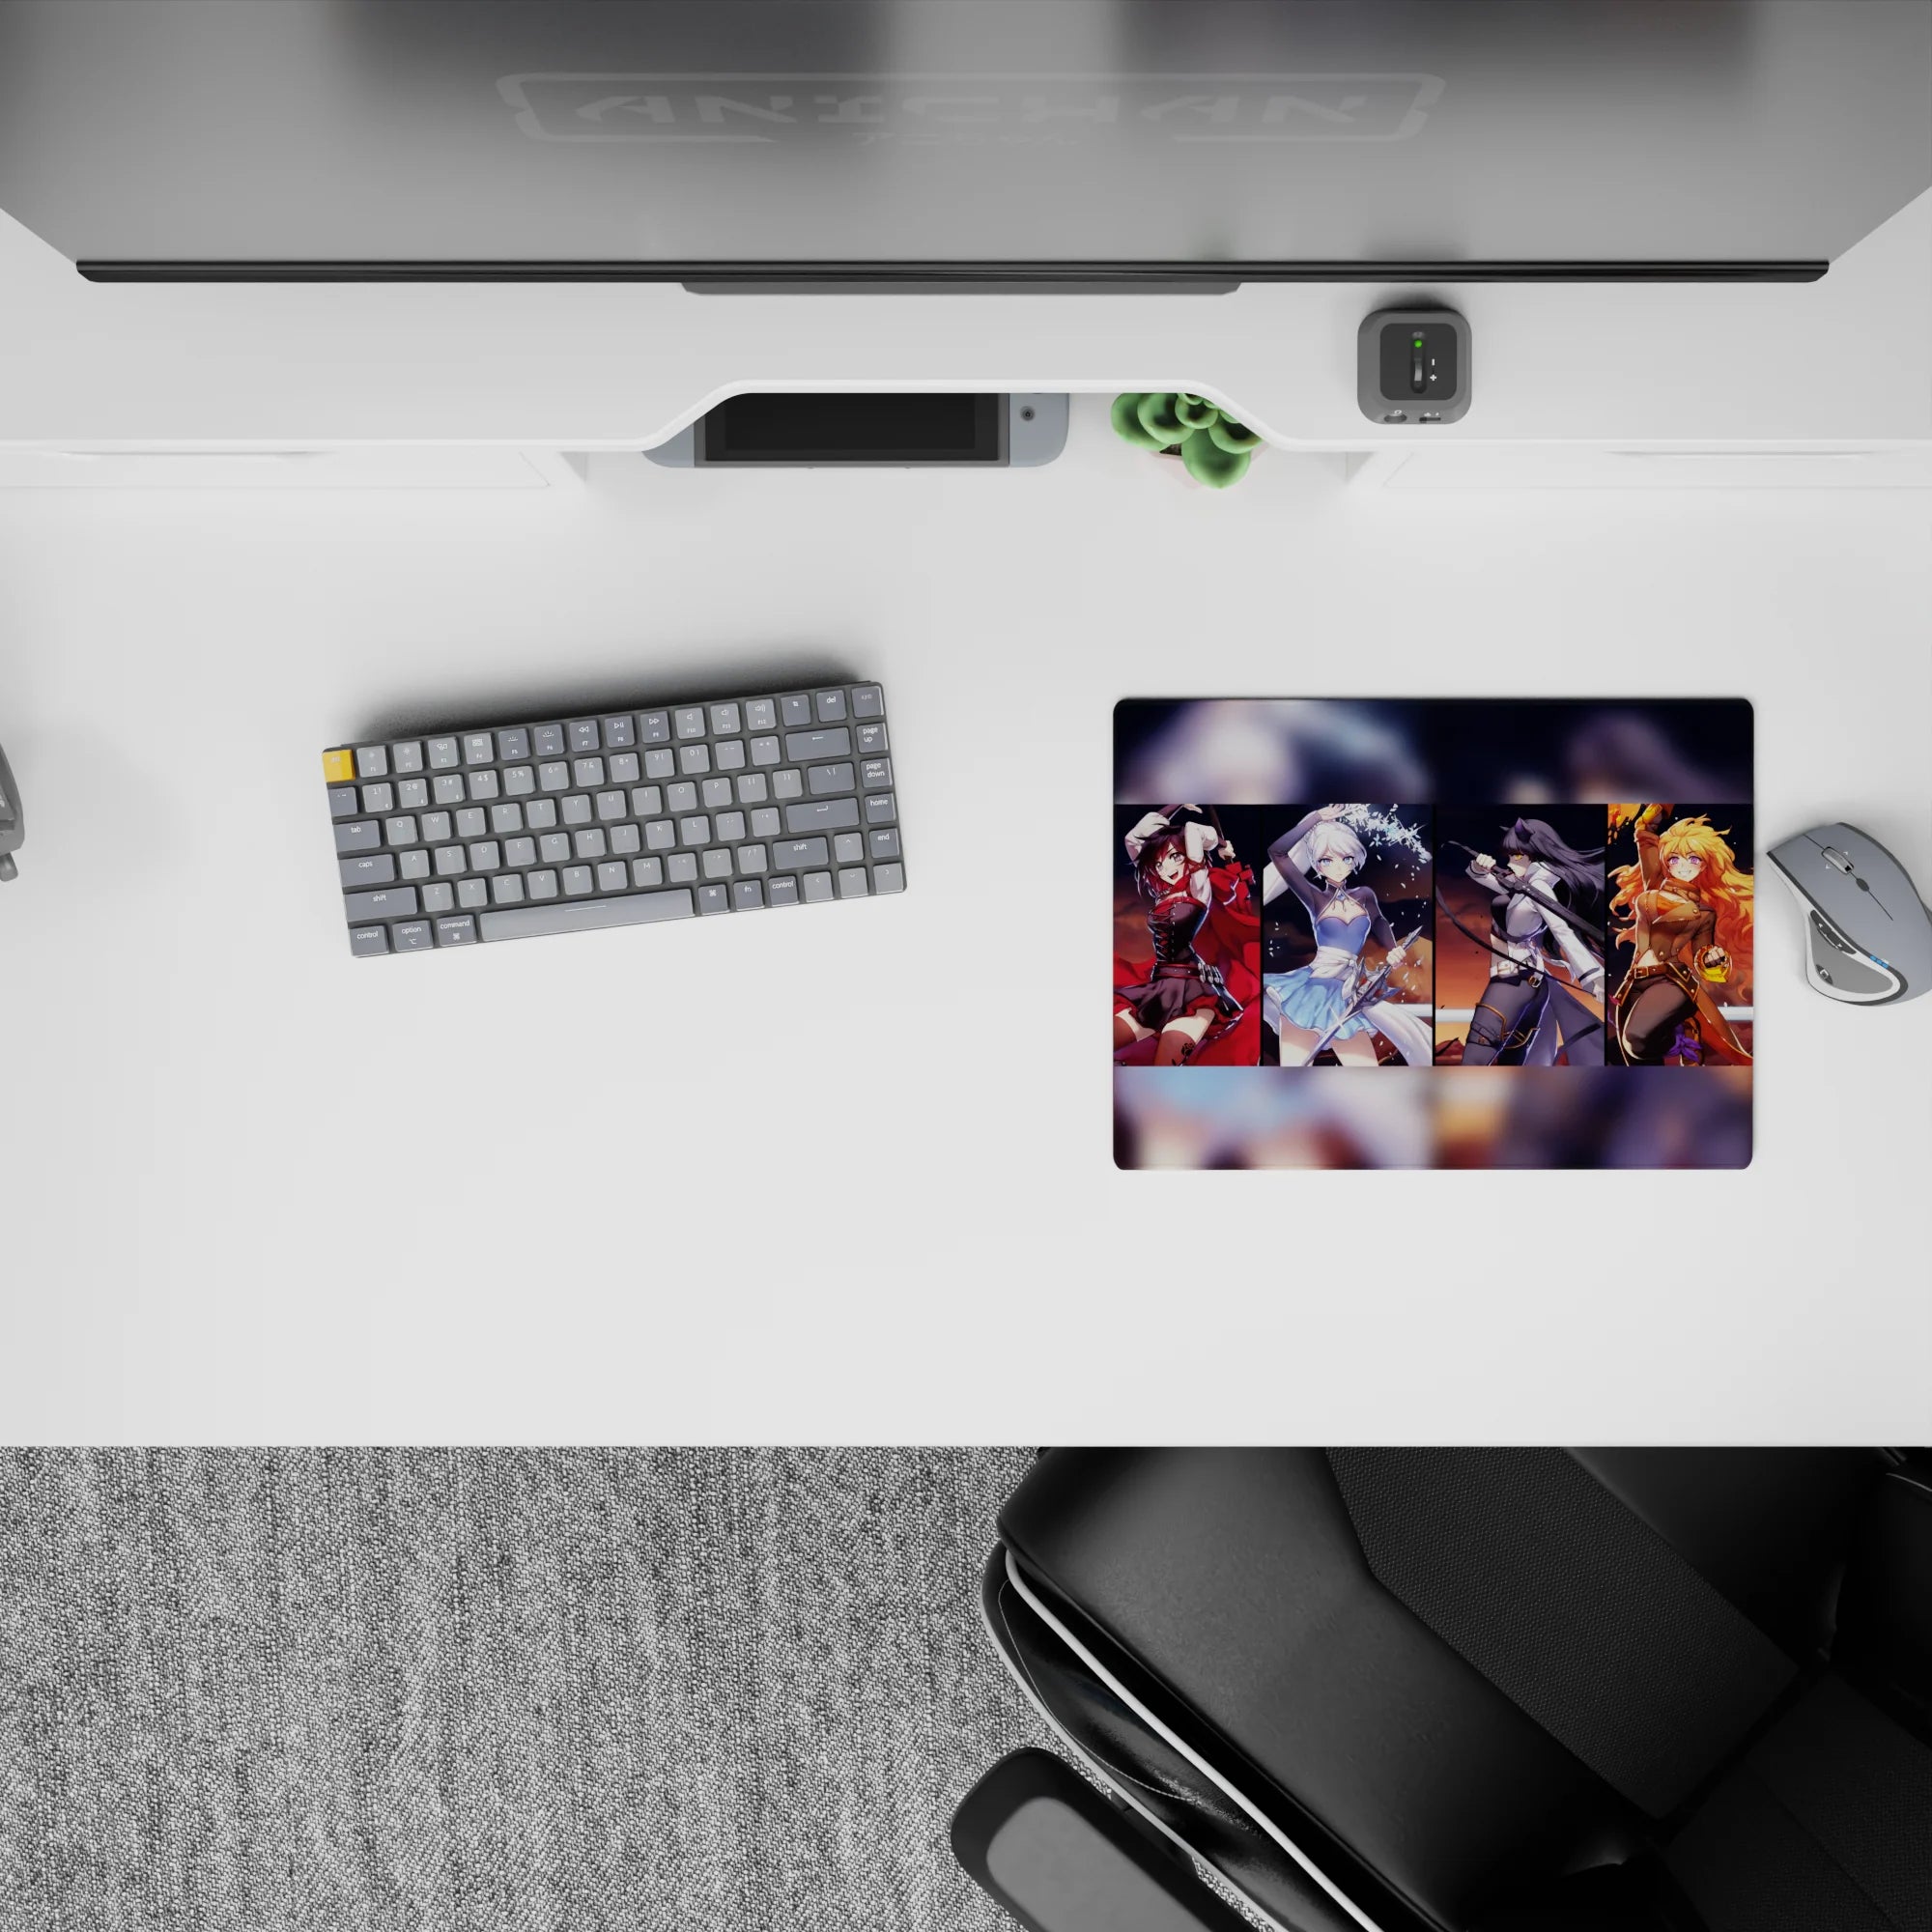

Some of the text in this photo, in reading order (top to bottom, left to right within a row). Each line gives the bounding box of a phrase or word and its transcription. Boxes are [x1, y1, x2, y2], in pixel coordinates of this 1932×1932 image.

[574, 96, 1368, 123] ANICHAN
[440, 920, 469, 929] command
[402, 925, 421, 934] option
